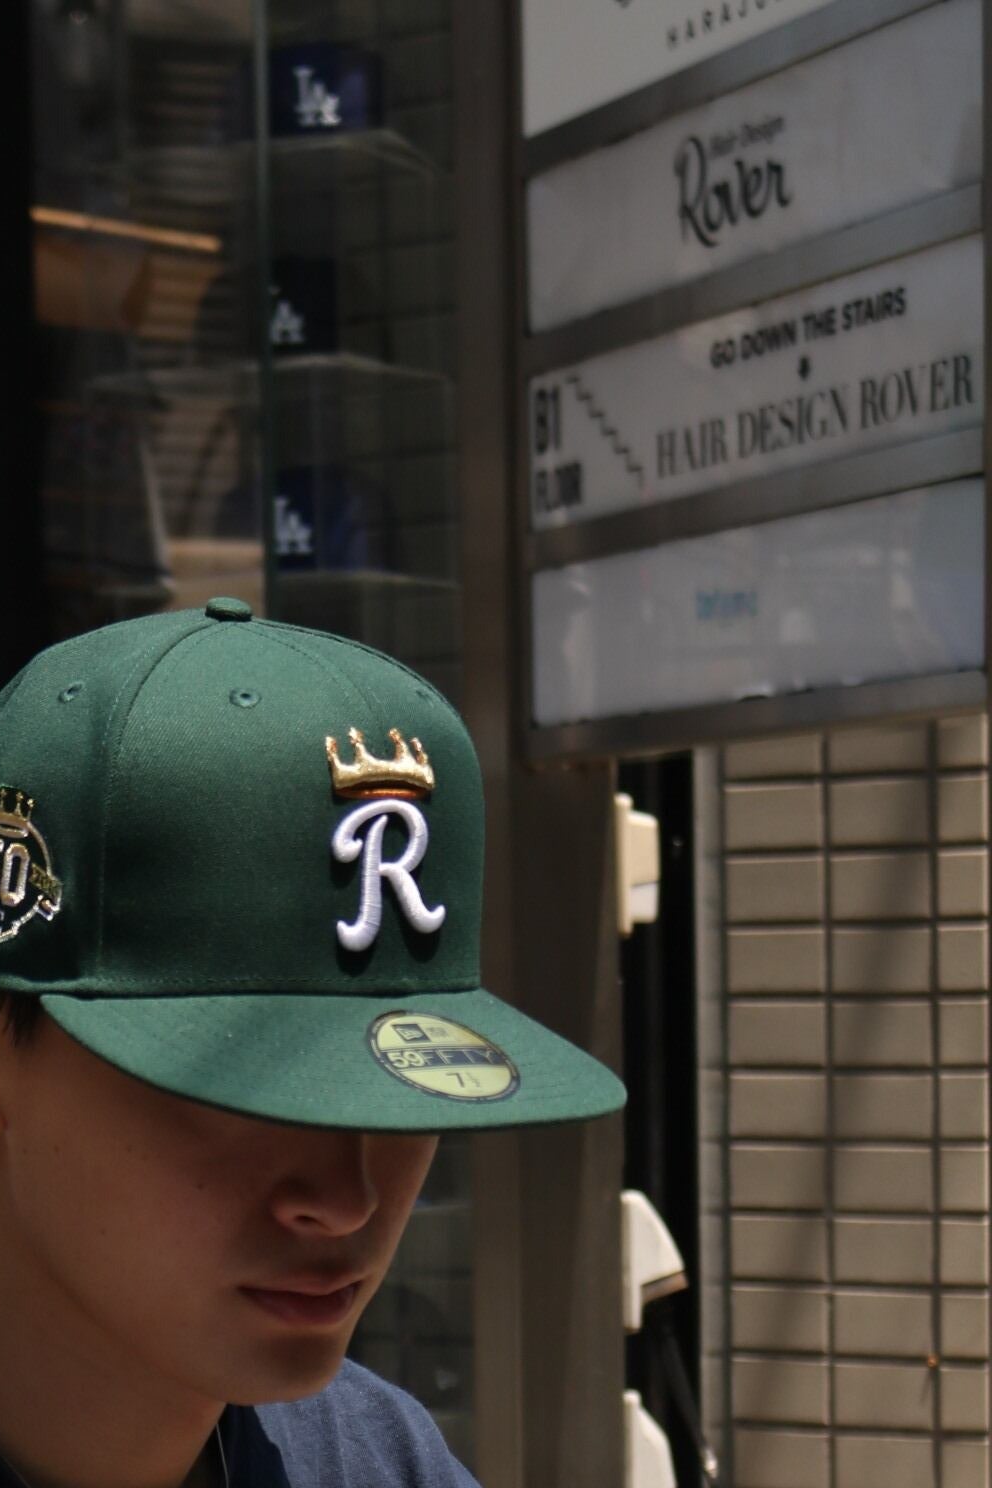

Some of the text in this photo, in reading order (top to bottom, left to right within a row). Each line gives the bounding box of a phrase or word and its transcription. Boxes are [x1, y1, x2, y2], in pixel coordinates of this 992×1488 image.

[674, 136, 793, 249] Rover
[710, 285, 907, 370] GO DOWN THE STAIRS
[655, 353, 974, 480] HAIR DESIGN ROVER
[332, 799, 446, 952] R
